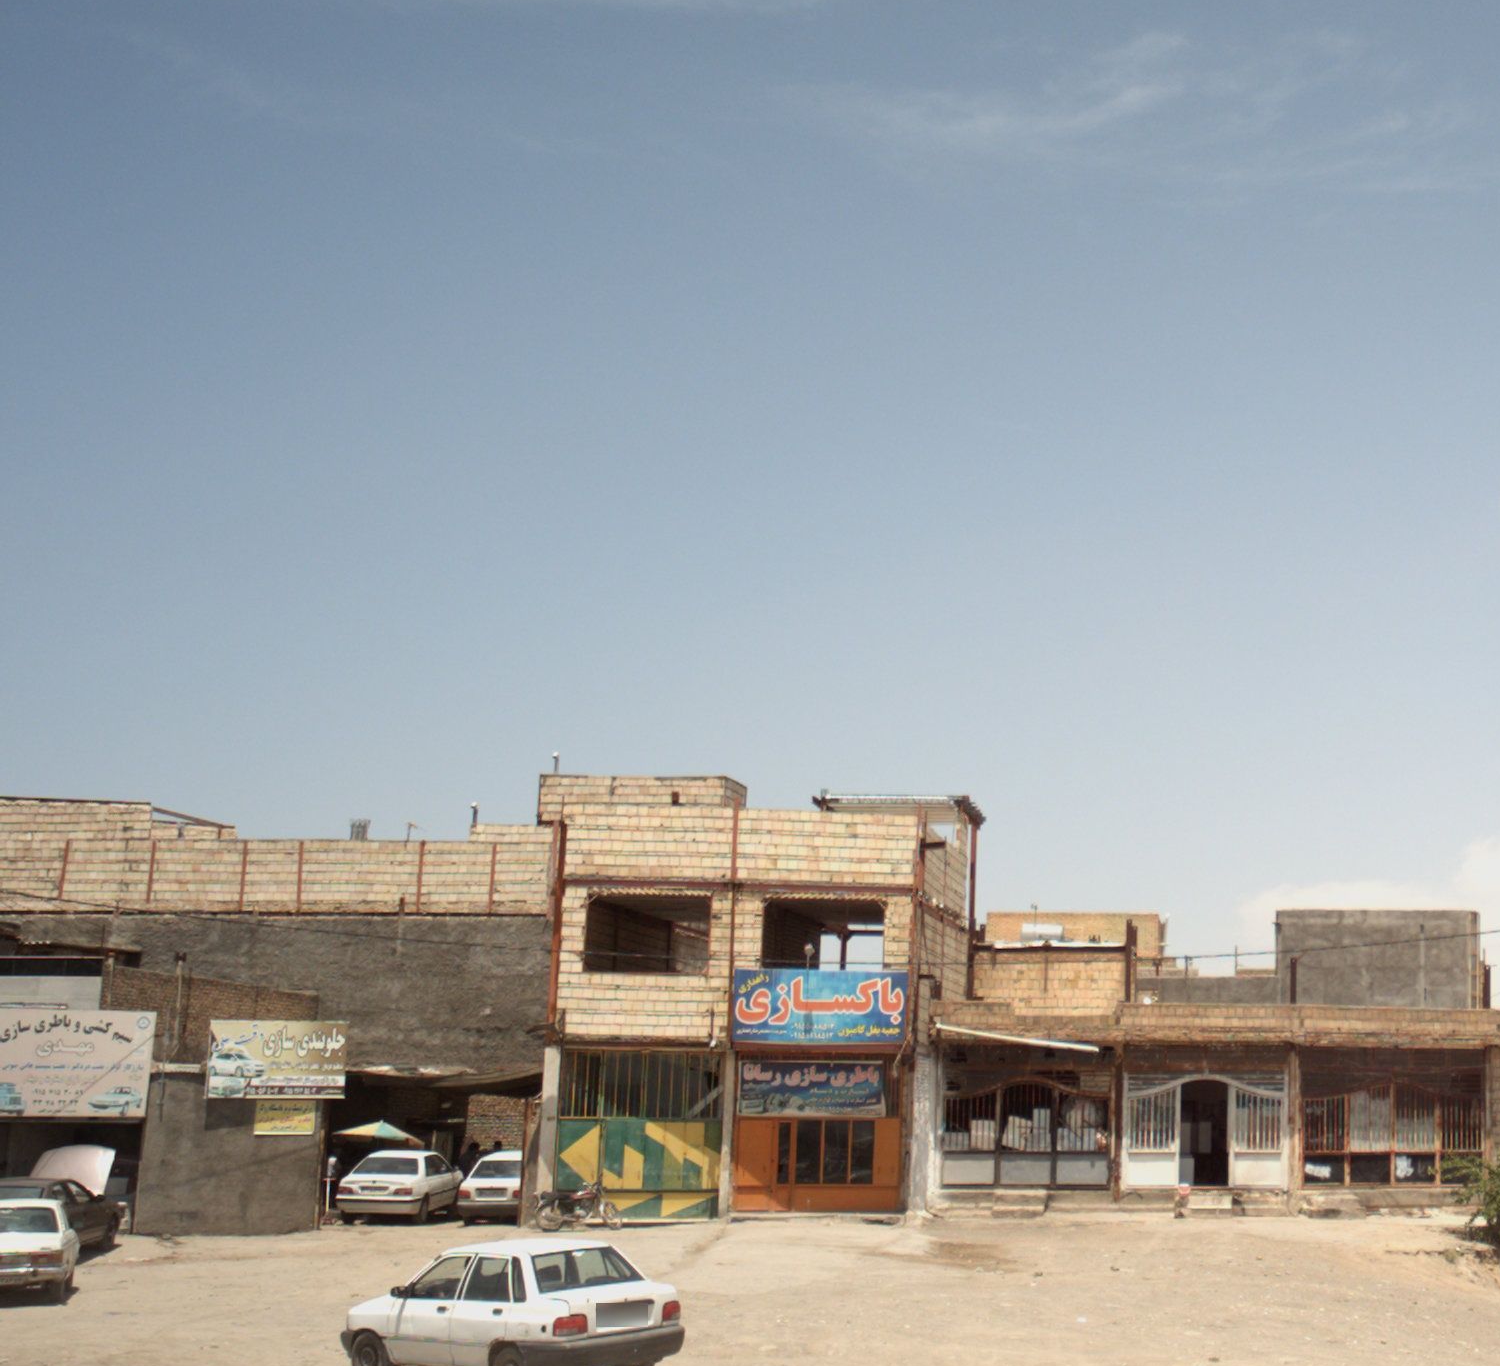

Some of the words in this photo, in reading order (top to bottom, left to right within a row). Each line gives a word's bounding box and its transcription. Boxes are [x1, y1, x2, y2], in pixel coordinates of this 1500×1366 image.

[0, 1020, 31, 1043] سازی
[34, 1014, 71, 1034] باطری
[73, 1021, 81, 1033] و
[83, 1019, 113, 1034] کشی
[35, 1038, 95, 1057] مهدی
[111, 1032, 133, 1044] سیم
[262, 1025, 295, 1057] سازی
[297, 1028, 346, 1057] جلوبندی
[743, 1063, 782, 1087] رسانا
[784, 1065, 828, 1087] سازی
[830, 1066, 880, 1087] باطری
